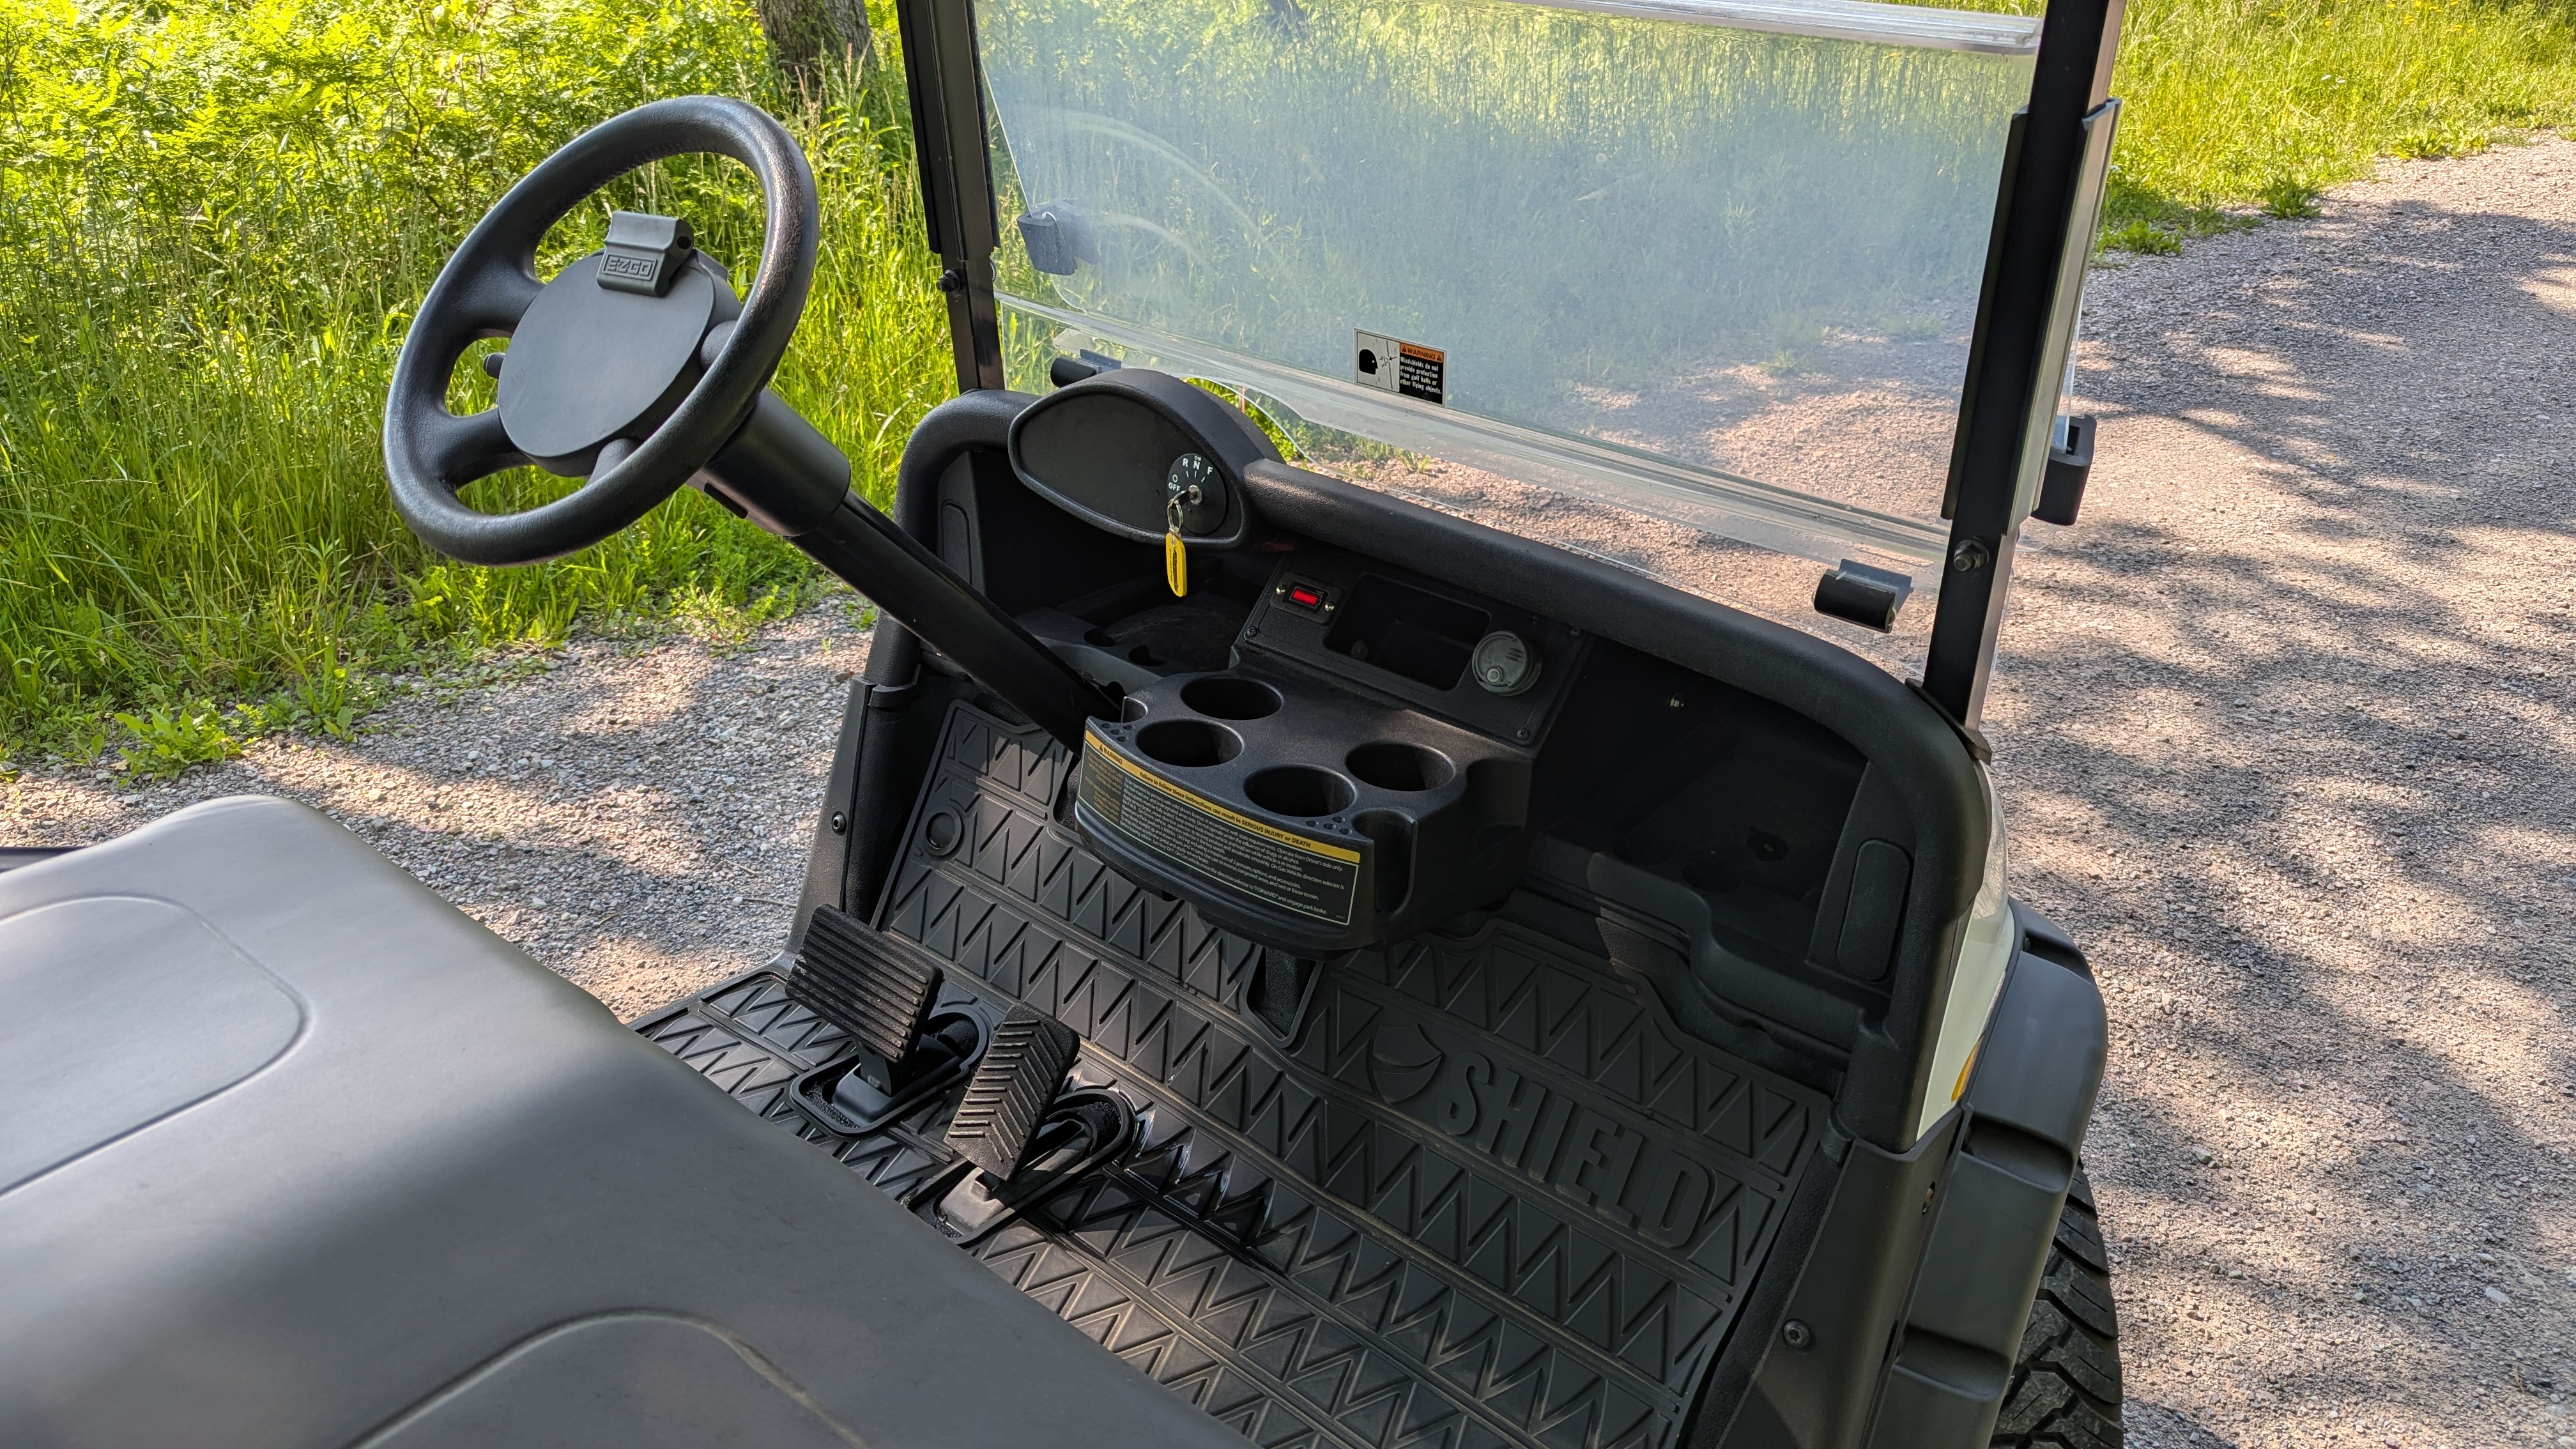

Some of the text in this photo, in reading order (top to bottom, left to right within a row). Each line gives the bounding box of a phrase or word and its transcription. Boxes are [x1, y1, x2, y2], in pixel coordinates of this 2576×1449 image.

[1407, 347, 1436, 360] WARNING
[1400, 356, 1424, 368] Windshields
[1400, 365, 1438, 379] provide protection
[1412, 381, 1424, 391] flying
[1425, 384, 1443, 395] objects.
[1182, 457, 1214, 475] R N F
[1168, 482, 1181, 492] OFF
[1140, 772, 1153, 783] Failure
[1158, 781, 1172, 792] follow
[1172, 789, 1184, 798] these
[1185, 794, 1211, 811] instructions
[1221, 812, 1235, 821] result
[1241, 820, 1263, 832] SERIOUS
[1264, 828, 1284, 839] INJURY
[1291, 838, 1310, 848] DEATH
[1265, 849, 1277, 857] drugs
[1282, 855, 1299, 864] alcohol.
[1276, 847, 1294, 857] Operate
[1305, 856, 1322, 865] Driver's
[1285, 863, 1302, 871] motion.
[1302, 874, 1322, 883] direction
[1436, 1051, 1714, 1248] SHIELD
